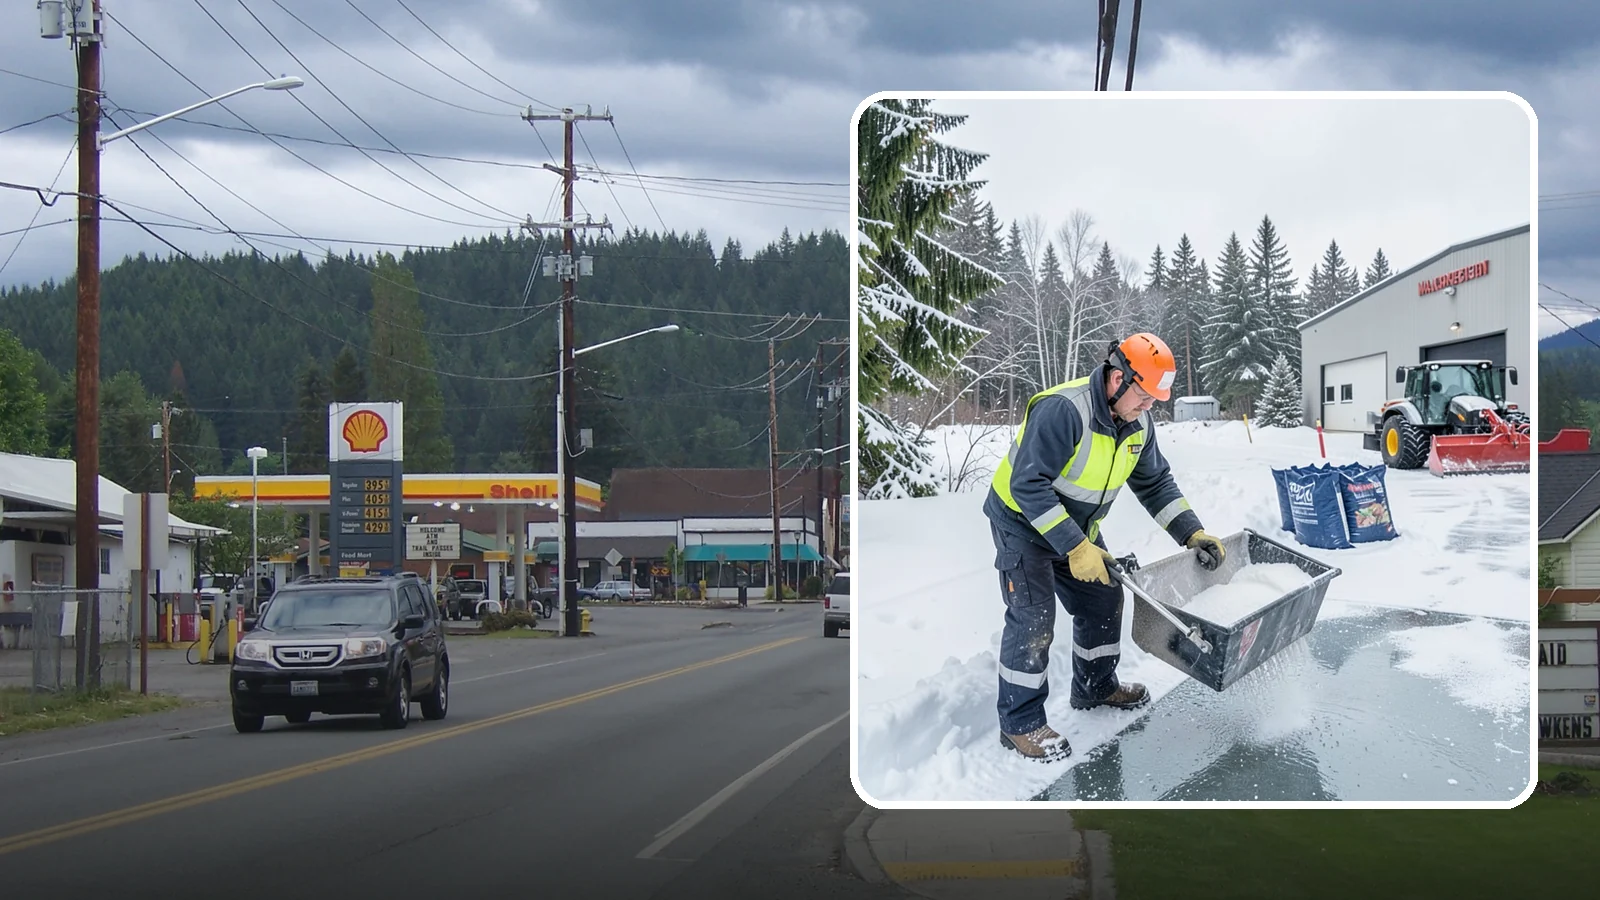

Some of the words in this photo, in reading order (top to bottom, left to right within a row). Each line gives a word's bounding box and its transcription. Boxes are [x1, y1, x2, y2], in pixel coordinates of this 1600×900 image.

[366, 480, 383, 490] 395
[490, 484, 547, 499] Shell
[366, 494, 383, 504] 405
[366, 508, 383, 518] 415
[366, 523, 383, 533] 429
